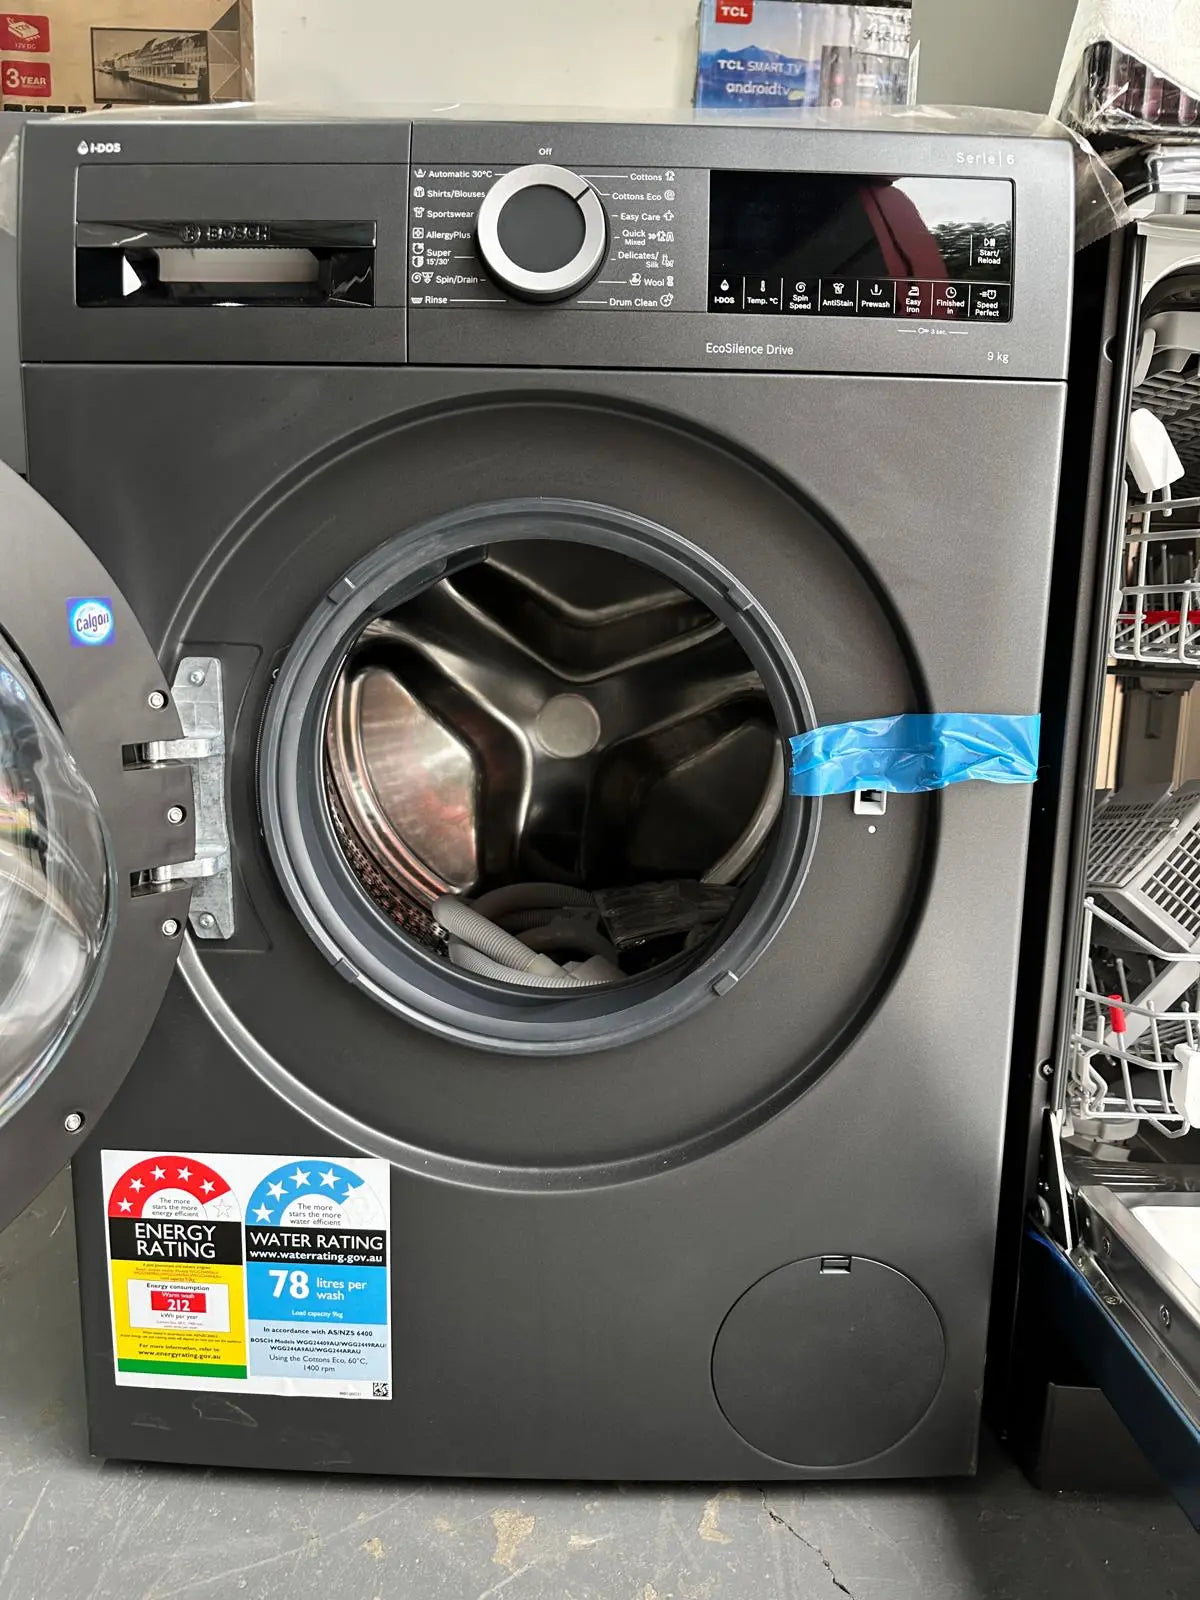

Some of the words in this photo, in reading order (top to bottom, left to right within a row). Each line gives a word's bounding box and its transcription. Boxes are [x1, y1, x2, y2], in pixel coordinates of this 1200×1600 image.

[721, 6, 748, 18] TCL
[717, 59, 745, 71] TCL
[746, 61, 784, 73] SMART
[785, 63, 802, 75] TV
[6, 68, 20, 88] 3
[20, 76, 46, 85] YEAR
[538, 147, 553, 156] Off
[956, 152, 996, 165] Serie
[1006, 154, 1015, 165] 6
[428, 170, 470, 178] Automatic
[630, 173, 662, 181] Cottons
[427, 190, 486, 199] Shirts/Blouses
[612, 192, 645, 200] Cottons
[646, 193, 662, 201] Eco
[427, 210, 474, 219] Sportswear
[620, 212, 640, 222] Easy
[641, 213, 661, 221] Care
[207, 225, 271, 241] BOSCH
[426, 231, 471, 240] AllergyPlus
[622, 229, 646, 238] Quick
[427, 249, 452, 258] Super
[618, 251, 659, 260] Delicates/
[979, 249, 1000, 257] Start/
[645, 261, 659, 269] Silk
[977, 257, 1001, 265] Reload
[435, 275, 478, 285] Spin/Drain
[644, 278, 665, 287] Wool
[425, 295, 448, 304] Rinse
[609, 298, 632, 306] Drum
[634, 298, 658, 307] Clean
[747, 296, 768, 305] Temp.
[792, 294, 809, 302] Spin
[905, 298, 921, 306] Easy
[789, 302, 812, 310] Speed
[822, 299, 854, 307] AntiStain
[861, 300, 890, 309] Prewash
[936, 299, 965, 308] Finished
[977, 301, 998, 310] Speed
[975, 309, 1000, 317] Perfect
[706, 342, 763, 354] EcoSilence
[766, 344, 794, 355] Drive
[987, 351, 994, 361] 9
[997, 352, 1009, 364] kg
[76, 612, 110, 632] Calgon
[152, 1210, 172, 1218] energy
[135, 1222, 217, 1241] ENERGY
[250, 1232, 311, 1248] WATER
[316, 1234, 383, 1250] RATING
[137, 1240, 216, 1259] RATING
[250, 1250, 383, 1263] www.waterrating.gov.au
[146, 1282, 168, 1290] Energy
[169, 1284, 210, 1292] consumption
[268, 1269, 310, 1299] 78
[316, 1277, 345, 1289] litres
[347, 1281, 367, 1291] per
[316, 1290, 345, 1300] wash
[167, 1299, 191, 1312] 212
[307, 1310, 331, 1318] capacity
[138, 1350, 221, 1360] www.energyrating.gov.au
[269, 1354, 288, 1363] Using
[302, 1355, 330, 1363] Cottons
